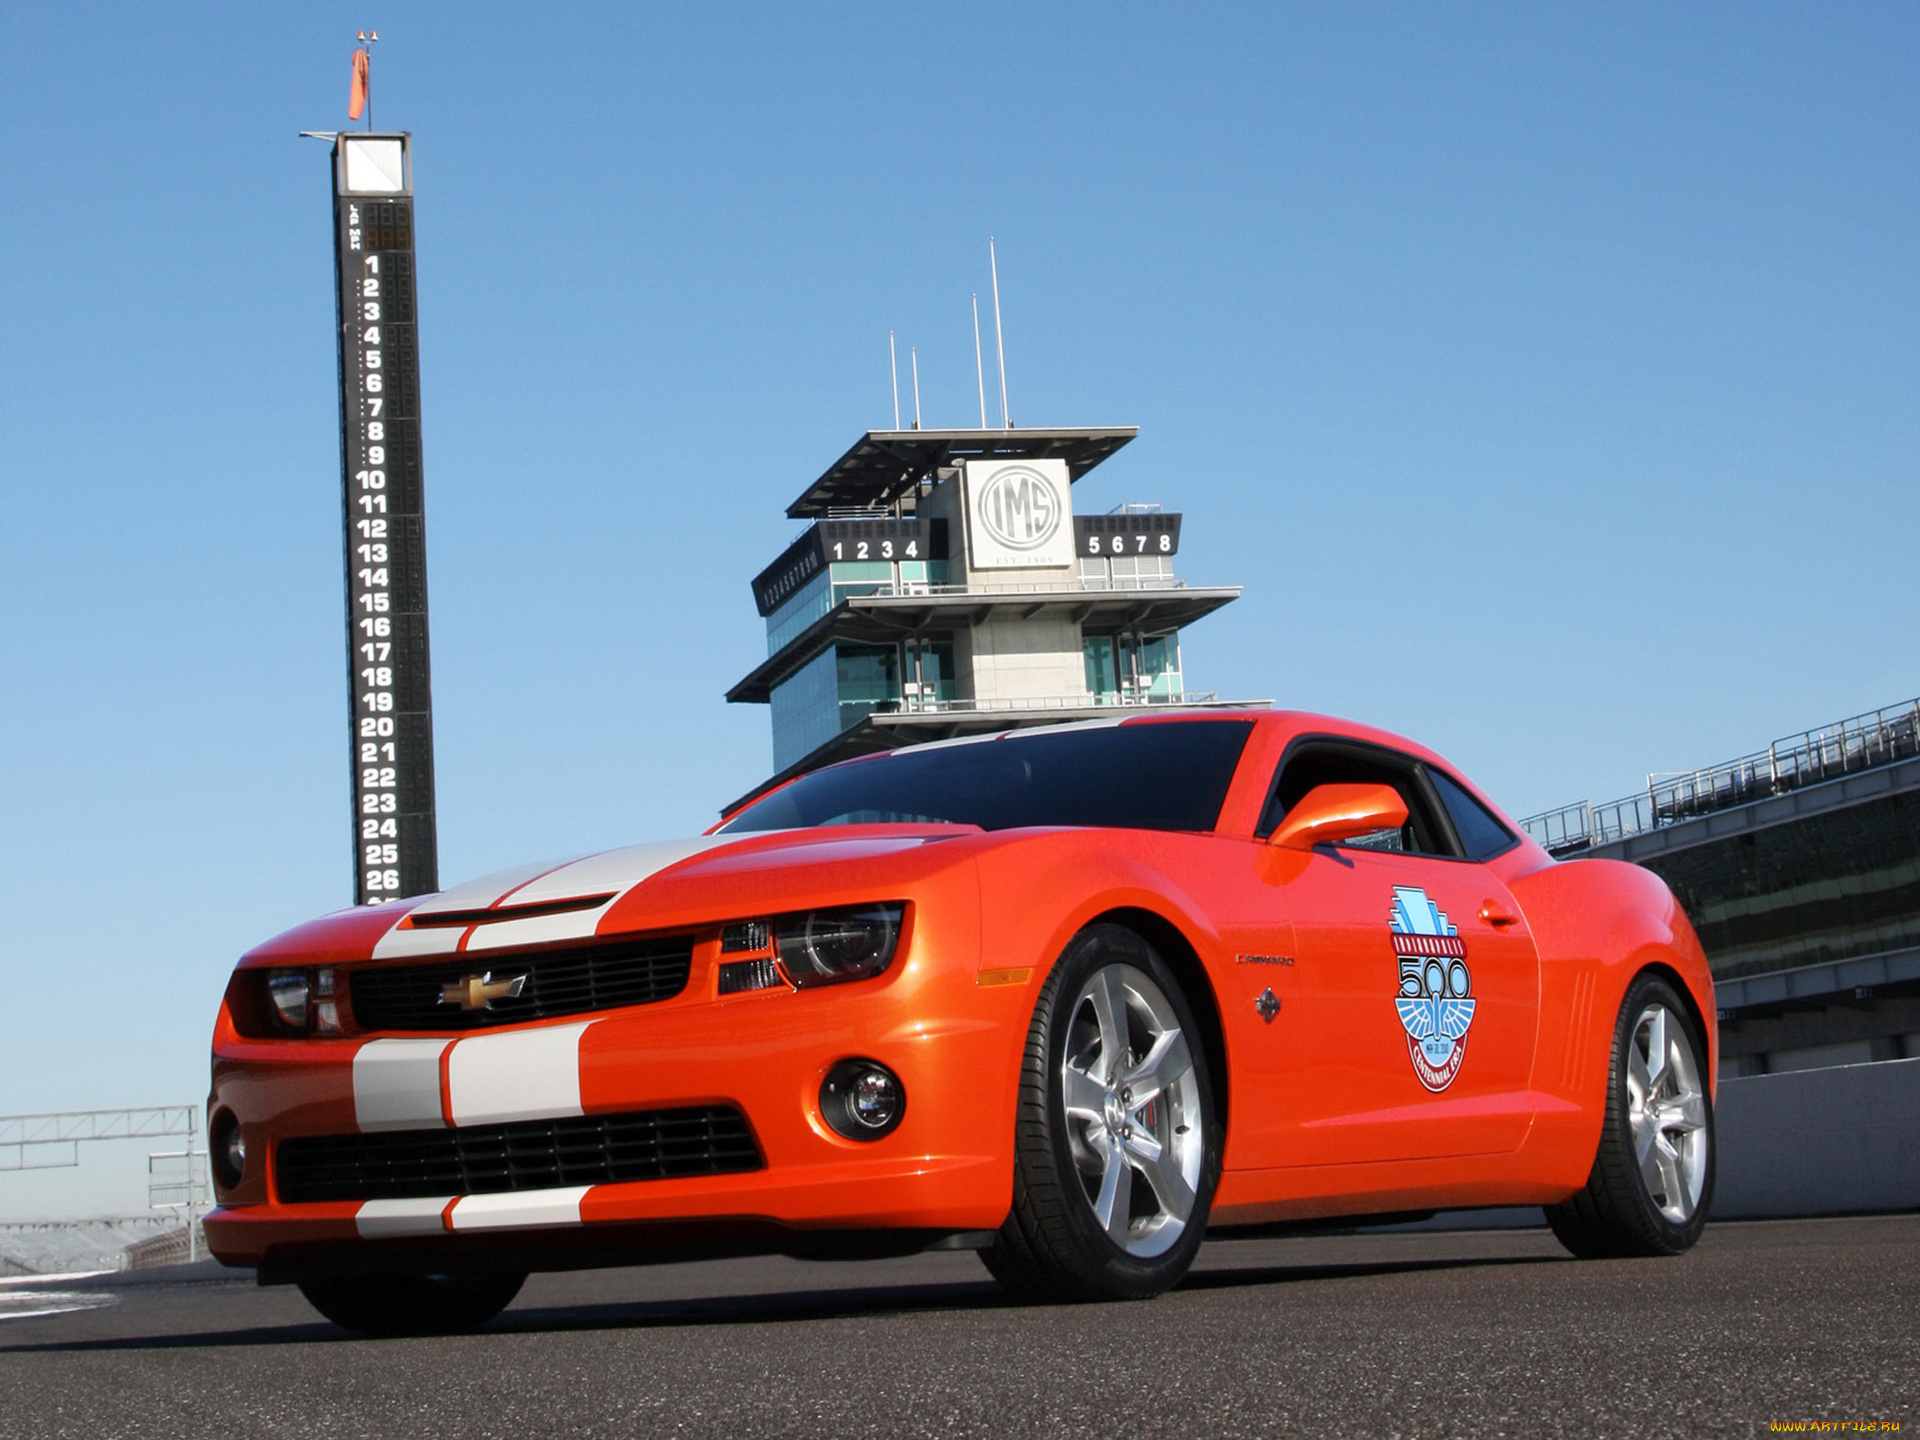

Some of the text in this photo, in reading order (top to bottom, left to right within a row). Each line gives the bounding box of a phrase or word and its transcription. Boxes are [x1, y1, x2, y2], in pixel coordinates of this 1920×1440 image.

[349, 204, 360, 225] LAP
[349, 229, 361, 250] MPH
[365, 256, 378, 273] 1
[363, 278, 379, 297] 2
[364, 302, 380, 321] 3
[364, 326, 380, 345] 4
[366, 350, 381, 369] 5
[366, 373, 382, 392] 6
[368, 398, 383, 417] 7
[368, 422, 384, 441] 8
[369, 446, 384, 465] 9
[356, 470, 385, 489] 10
[359, 494, 386, 513] 11
[993, 478, 1050, 539] IMS
[357, 519, 387, 538] 12
[357, 543, 388, 563] 13
[833, 541, 919, 560] 1 2 3 4
[1089, 534, 1171, 554] 5 6 7 8
[1027, 556, 1053, 564] 1909
[358, 568, 389, 587] 14
[359, 592, 389, 612] 15
[360, 617, 390, 637] 16
[361, 642, 391, 662] 17
[361, 667, 392, 687] 18
[362, 692, 393, 711] 19
[361, 717, 393, 737] 20
[361, 742, 395, 763] 21
[363, 767, 396, 788] 22
[363, 793, 396, 813] 23
[363, 818, 397, 839] 24
[366, 844, 398, 865] 25
[366, 869, 399, 890] 26
[1397, 955, 1472, 998] 500
[1413, 1045, 1462, 1085] CENTENNIAL ERA
